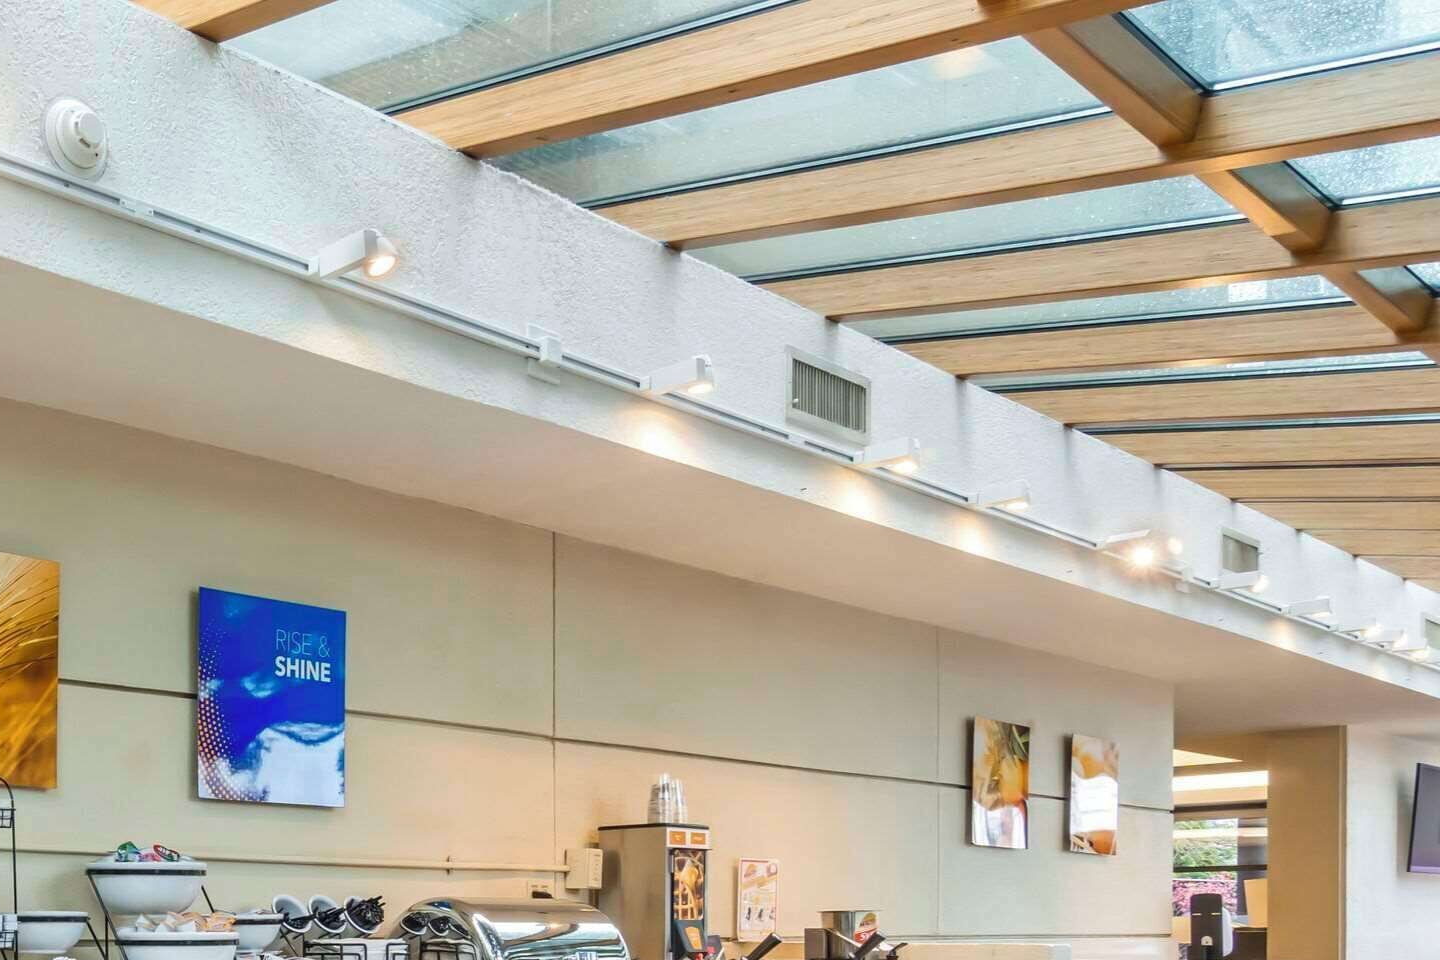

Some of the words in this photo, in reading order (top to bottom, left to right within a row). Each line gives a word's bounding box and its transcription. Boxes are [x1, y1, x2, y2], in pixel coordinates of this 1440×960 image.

[275, 628, 313, 656] RISE
[318, 635, 331, 658] &
[274, 655, 332, 683] SHINE
